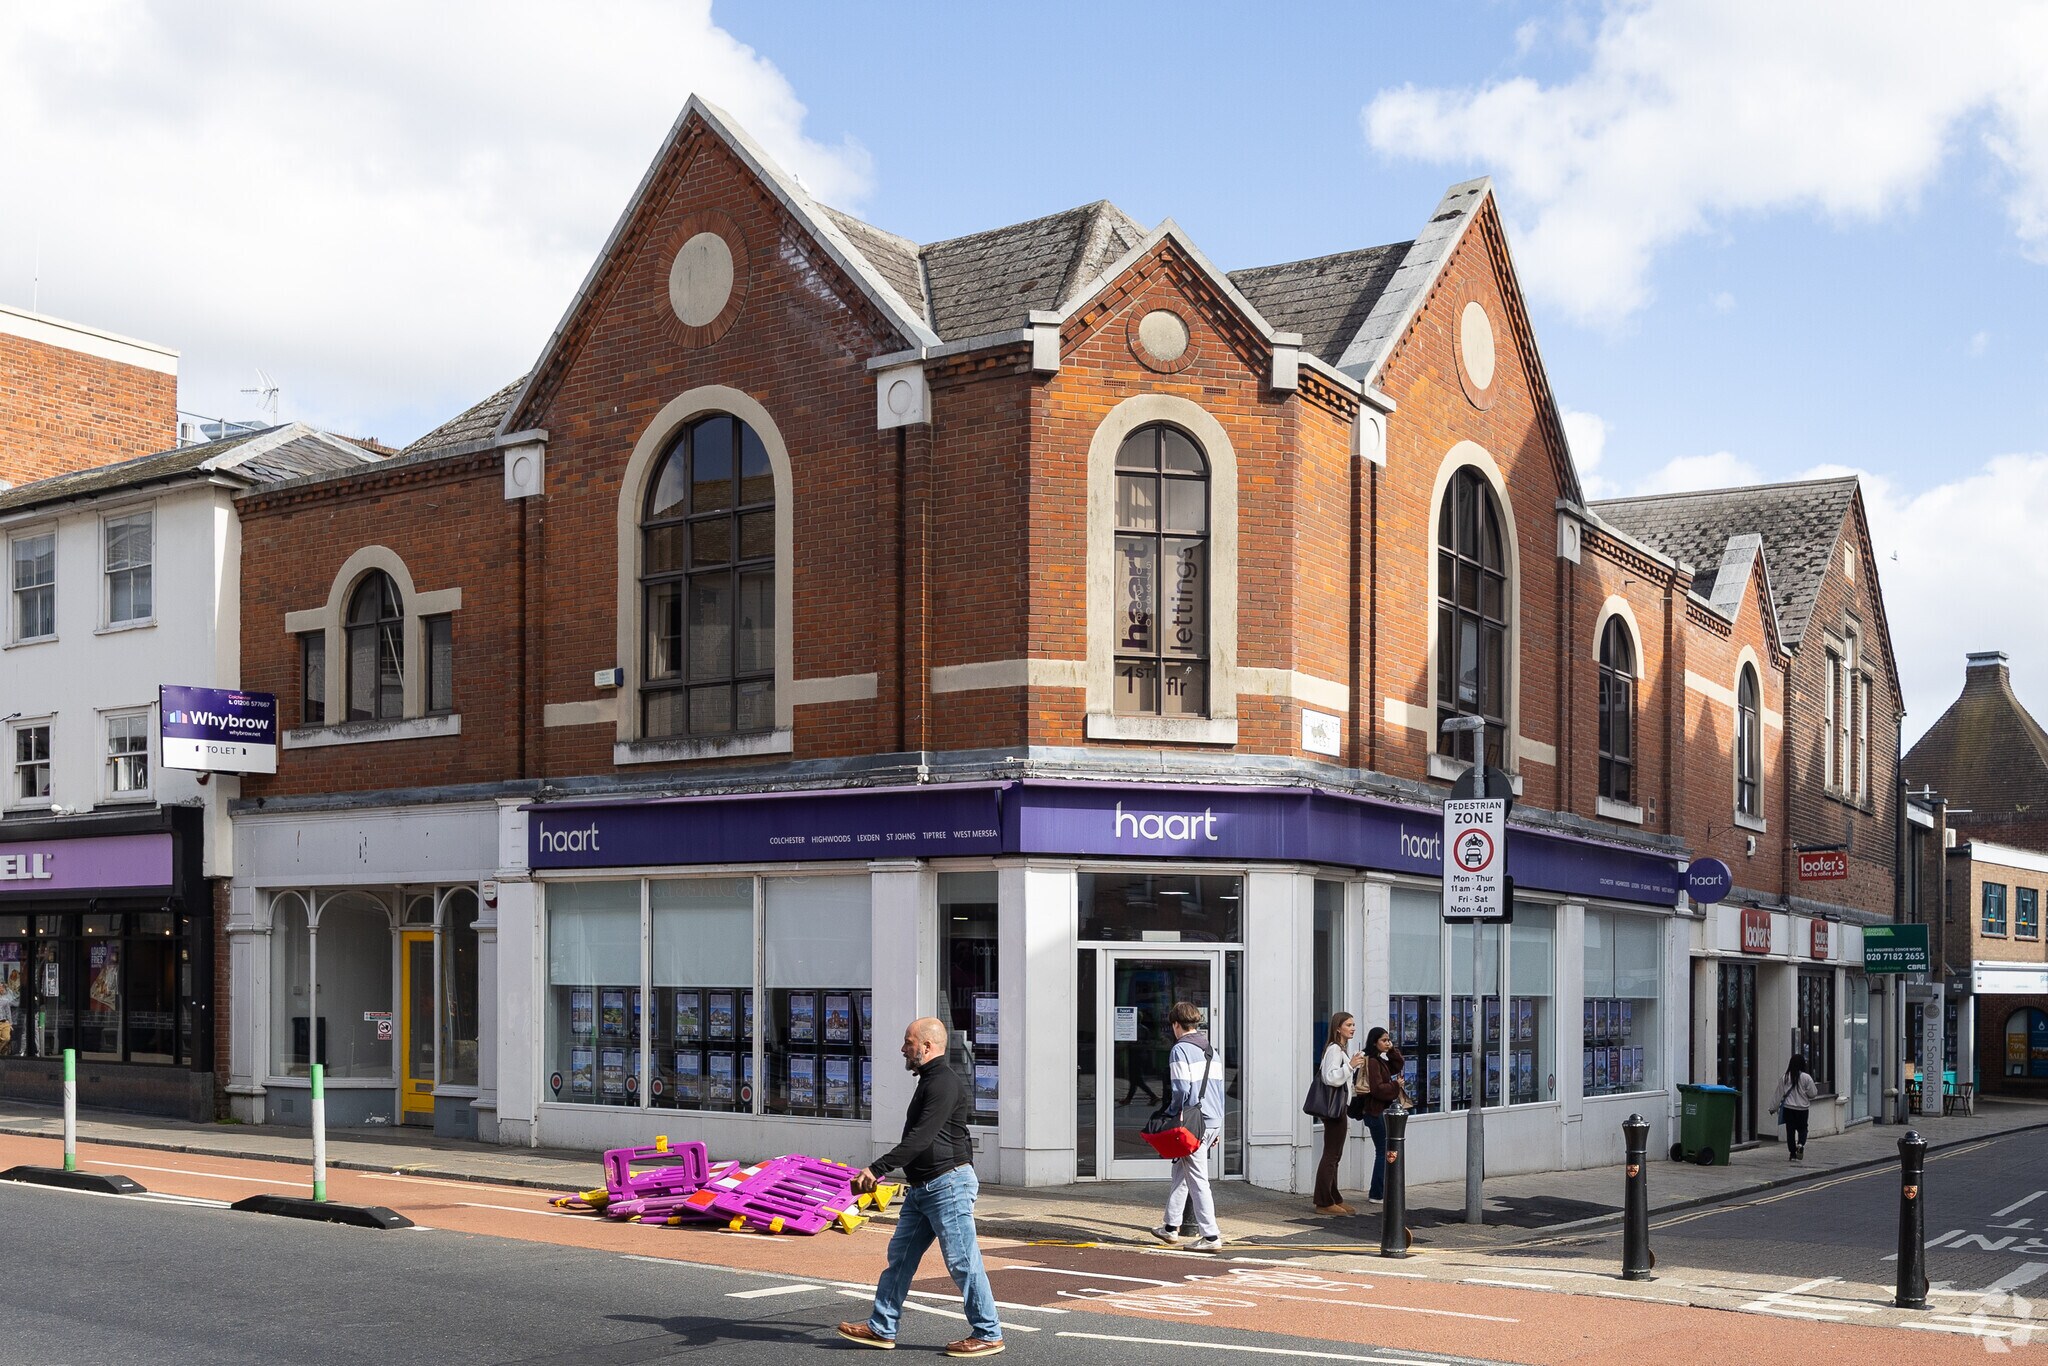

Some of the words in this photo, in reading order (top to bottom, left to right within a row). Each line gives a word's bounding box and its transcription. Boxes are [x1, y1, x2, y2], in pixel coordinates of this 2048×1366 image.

[1121, 543, 1148, 649] haart
[1170, 546, 1198, 651] lettings
[1165, 676, 1188, 697] flr
[189, 710, 269, 730] Whybrow
[206, 745, 218, 754] TO
[220, 746, 236, 755] LET
[1447, 801, 1502, 810] PEDESTRIAN
[1115, 800, 1218, 841] haart
[1454, 812, 1493, 824] ZONE
[539, 820, 600, 852] haart
[769, 836, 806, 845] COLCHESTER
[811, 835, 851, 844] HIGHWOODS
[857, 834, 880, 842] LEXDEN
[886, 833, 894, 841] ST
[894, 832, 916, 841] JOHNS
[922, 831, 947, 840] TIPTREE
[953, 830, 971, 839] WEST
[971, 829, 998, 838] MERSEA
[1400, 822, 1441, 861] haart
[1800, 856, 1845, 872] loofer's
[1475, 874, 1494, 882] Thur
[1689, 873, 1723, 886] haart
[1450, 905, 1471, 913] Noon
[1866, 953, 1881, 961] 020
[1905, 952, 1925, 960] 2655
[1927, 1023, 1938, 1043] Hot
[1926, 1046, 1938, 1110] Sandwiches
